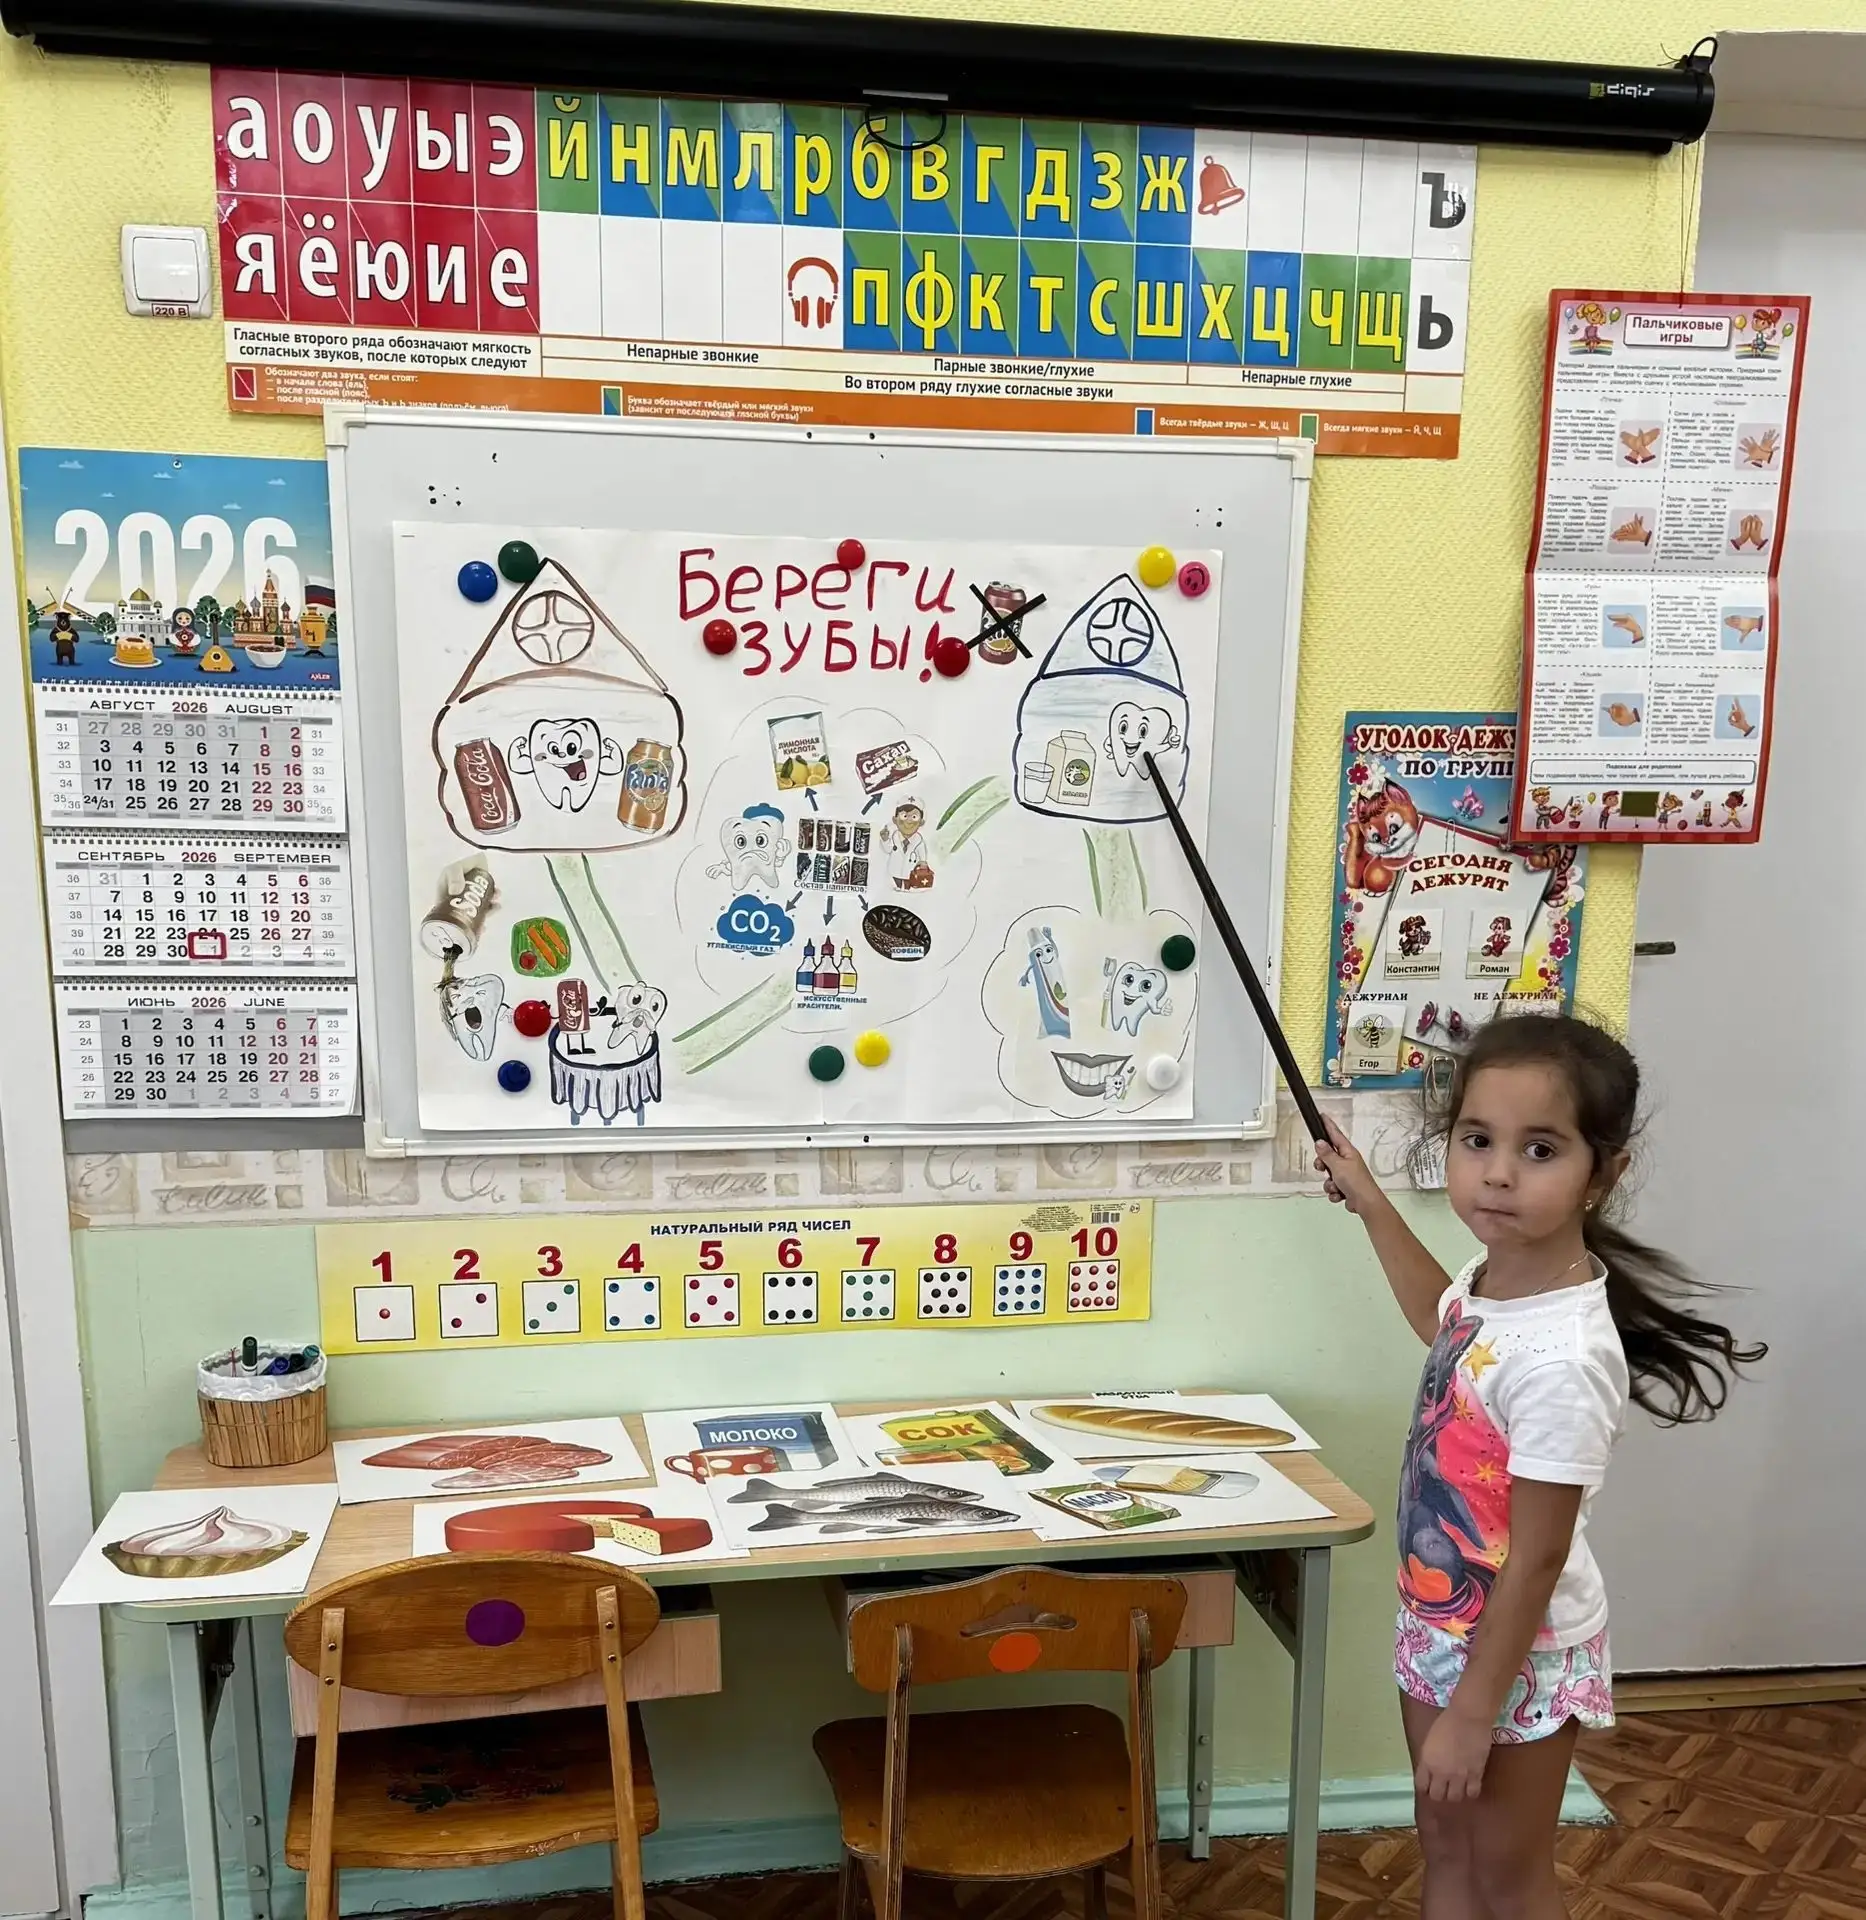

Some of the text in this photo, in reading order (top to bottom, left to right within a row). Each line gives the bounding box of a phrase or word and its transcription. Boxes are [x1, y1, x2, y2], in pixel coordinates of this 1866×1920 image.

[1607, 83, 1655, 98] digis
[226, 96, 270, 160] а
[357, 105, 399, 192] у
[415, 109, 470, 174] ы
[546, 95, 590, 181] й
[610, 123, 653, 186] н
[665, 126, 720, 190] м
[732, 129, 774, 192] л
[794, 133, 834, 217] р
[850, 116, 892, 201] б
[911, 141, 951, 203] в
[974, 144, 1005, 204] г
[1025, 147, 1072, 223] д
[155, 307, 174, 316] 220
[1632, 316, 1724, 331] Пальчиковые
[233, 327, 532, 355] Гласные второго ряда обозначают мягкость
[1659, 333, 1694, 344] игры
[239, 345, 528, 370] согласных звуков, после которых следуют
[626, 344, 760, 364] Непарные звонкие
[265, 366, 319, 379] Обозначают
[321, 370, 338, 380] два
[934, 358, 1095, 379] Парные звонкие/глухие
[1242, 370, 1353, 389] Непарные глухие
[844, 376, 1114, 400] Во втором ряду глухие согласные звуки
[55, 508, 301, 621] 2026
[90, 700, 293, 715] АВГУСТ 2026 AUGUST
[1358, 727, 1450, 751] УГОЛОК
[782, 744, 817, 756] КИСЛОТА
[862, 743, 908, 774] Сахар
[93, 759, 301, 776] 10 11 12 13 14 15 16
[1404, 760, 1437, 776] ПО
[77, 851, 331, 864] СЕНТЯБРЬ 2026 SEPTEMBER
[1408, 853, 1513, 873] СЕГОДНЯ
[1410, 873, 1509, 894] ДЕЖУРЯТ
[110, 891, 309, 904] 7 8 9 10 11 12 13
[450, 875, 489, 919] Soda
[1387, 964, 1440, 975] Константин
[1479, 964, 1510, 974] Роман
[128, 997, 286, 1008] ИЮНЬ 2026 JUNE
[1344, 993, 1408, 1002] ДЕЖУРИЛИ
[1474, 992, 1557, 1001] НЕ ДЕЖУРИЛИ
[114, 1053, 315, 1065] 15 16 17 18 19 20 21
[1359, 1059, 1379, 1069] Егор
[650, 1220, 851, 1235] НАТУРАЛЬНЫЙ РЯД ЧИСЕЛ
[372, 1227, 1119, 1282] 1 2 3 4 5 6 7 8 9 10
[709, 1427, 798, 1443] МОЛОКО
[898, 1422, 985, 1442] СОК
[1064, 1491, 1129, 1509] МАСЛО
